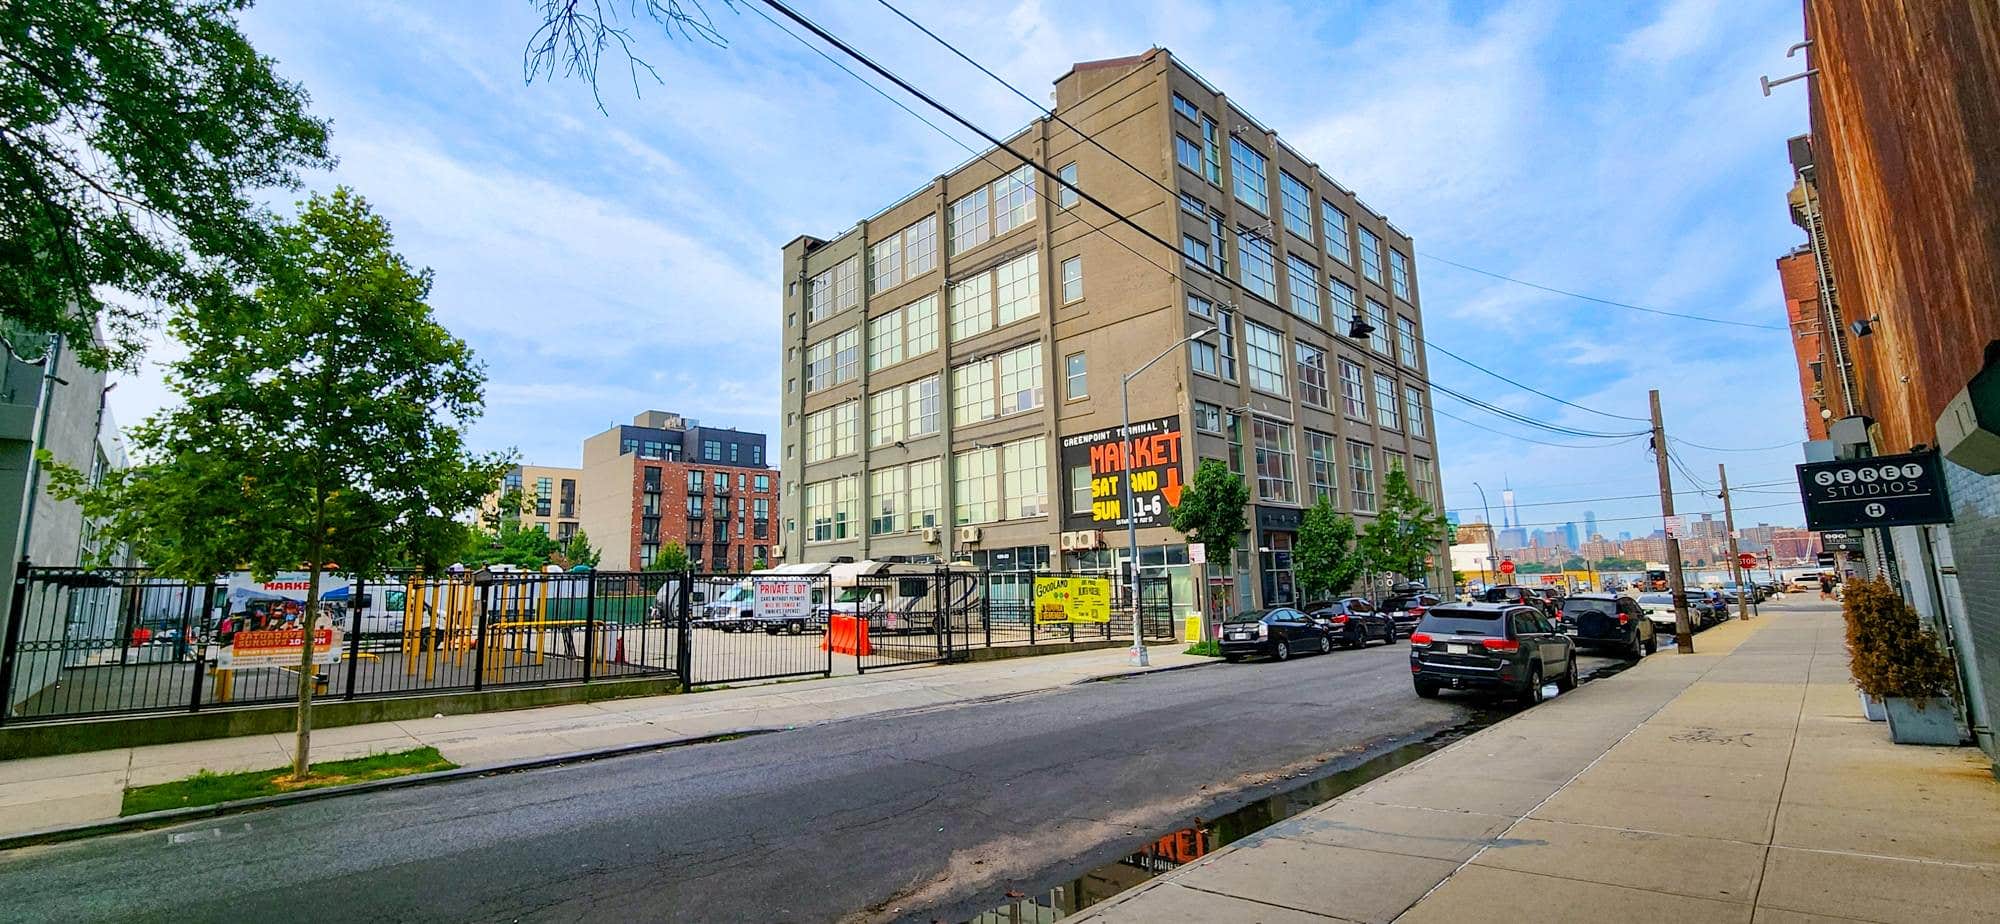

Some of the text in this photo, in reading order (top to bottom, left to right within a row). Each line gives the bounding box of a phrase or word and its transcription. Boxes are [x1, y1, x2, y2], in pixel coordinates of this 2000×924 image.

[1064, 430, 1111, 447] GREENPOINT
[1090, 431, 1182, 475] MARKET
[1817, 464, 1920, 485] SERET
[1091, 470, 1158, 498] SAT AND
[1826, 480, 1919, 498] STUDIOS
[1092, 499, 1121, 521] SUN
[264, 582, 311, 591] MARKE
[760, 584, 806, 594] PRIVATE LOT
[238, 637, 327, 648] SUNDAYS 10-PM
[239, 630, 303, 641] SATURDAYS
